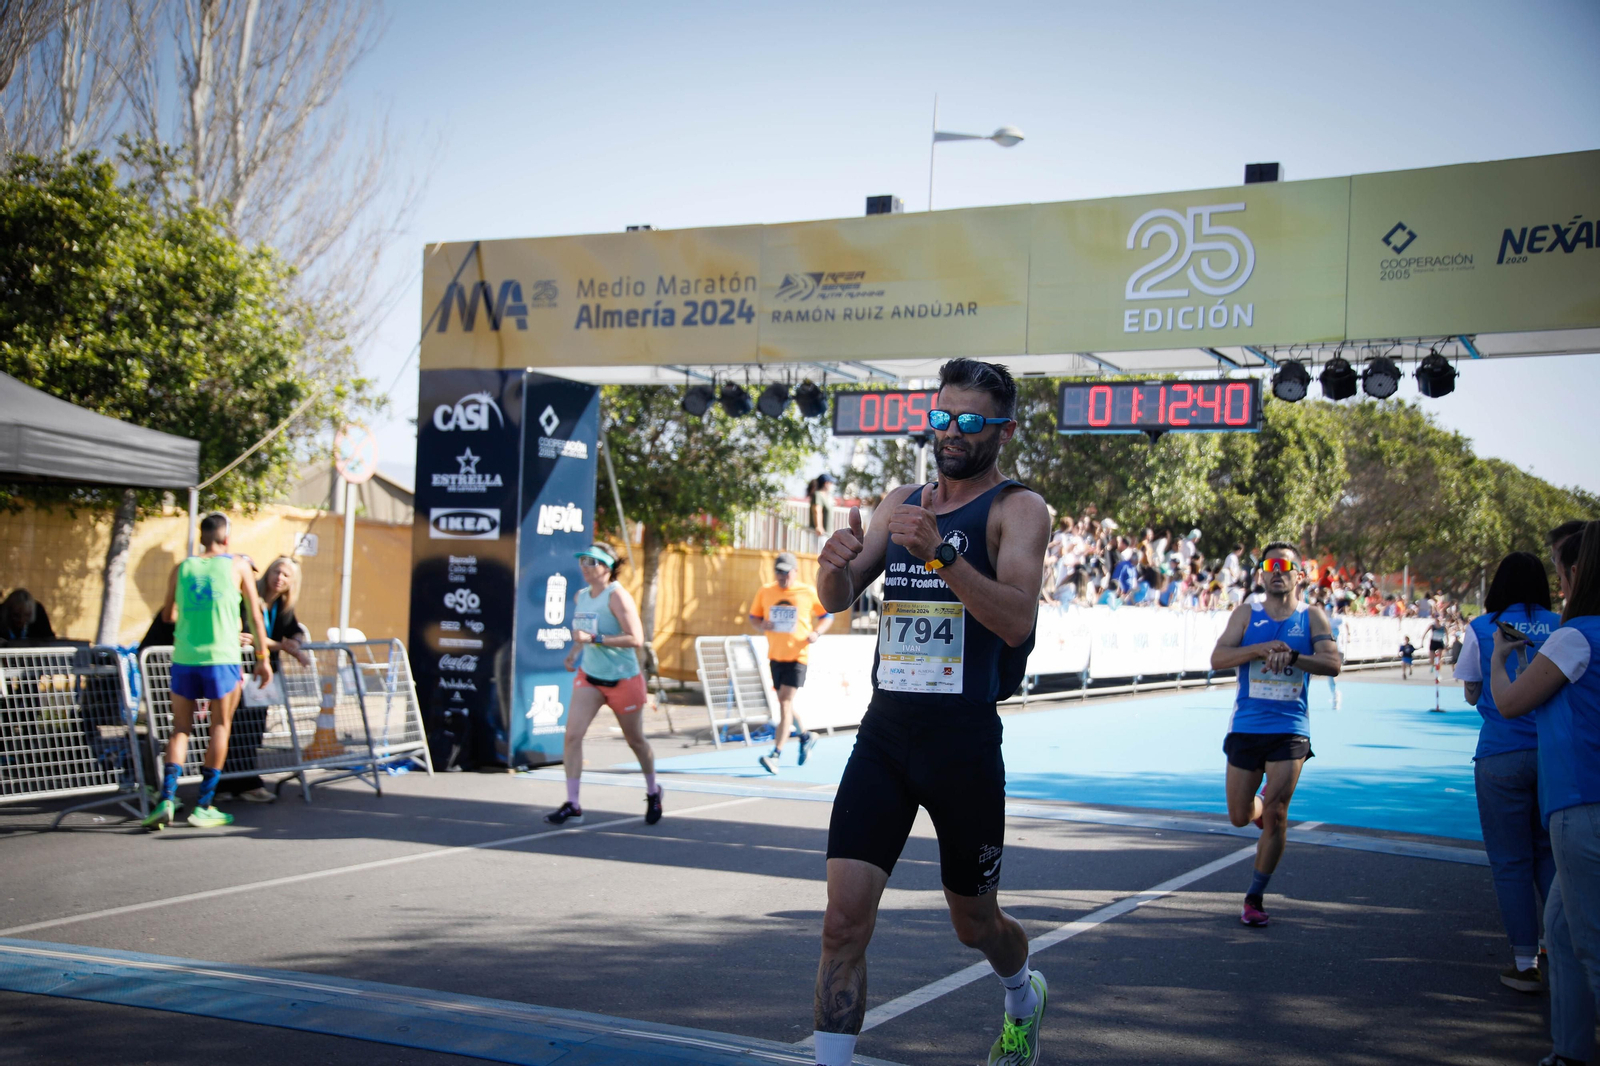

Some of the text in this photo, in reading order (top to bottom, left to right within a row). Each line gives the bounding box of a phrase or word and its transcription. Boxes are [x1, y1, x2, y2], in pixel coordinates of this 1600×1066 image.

[1125, 202, 1256, 299] 25
[1380, 252, 1473, 270] COOPERACIÓN
[1505, 256, 1528, 264] 2020
[576, 272, 757, 299] Medio Maratón
[1380, 269, 1410, 281] 2005
[574, 298, 755, 330] Almería 2024
[771, 299, 978, 324] RAMÓN RUIZ ANDÚJAR
[1123, 298, 1254, 332] EDICIÓN
[433, 402, 490, 431] CASI
[1088, 383, 1250, 427] 01:12:40
[431, 473, 504, 487] ESTRELLA
[439, 517, 492, 531] IKEA
[890, 563, 906, 572] CLUB
[444, 588, 480, 613] ego
[885, 616, 954, 645] 1794
